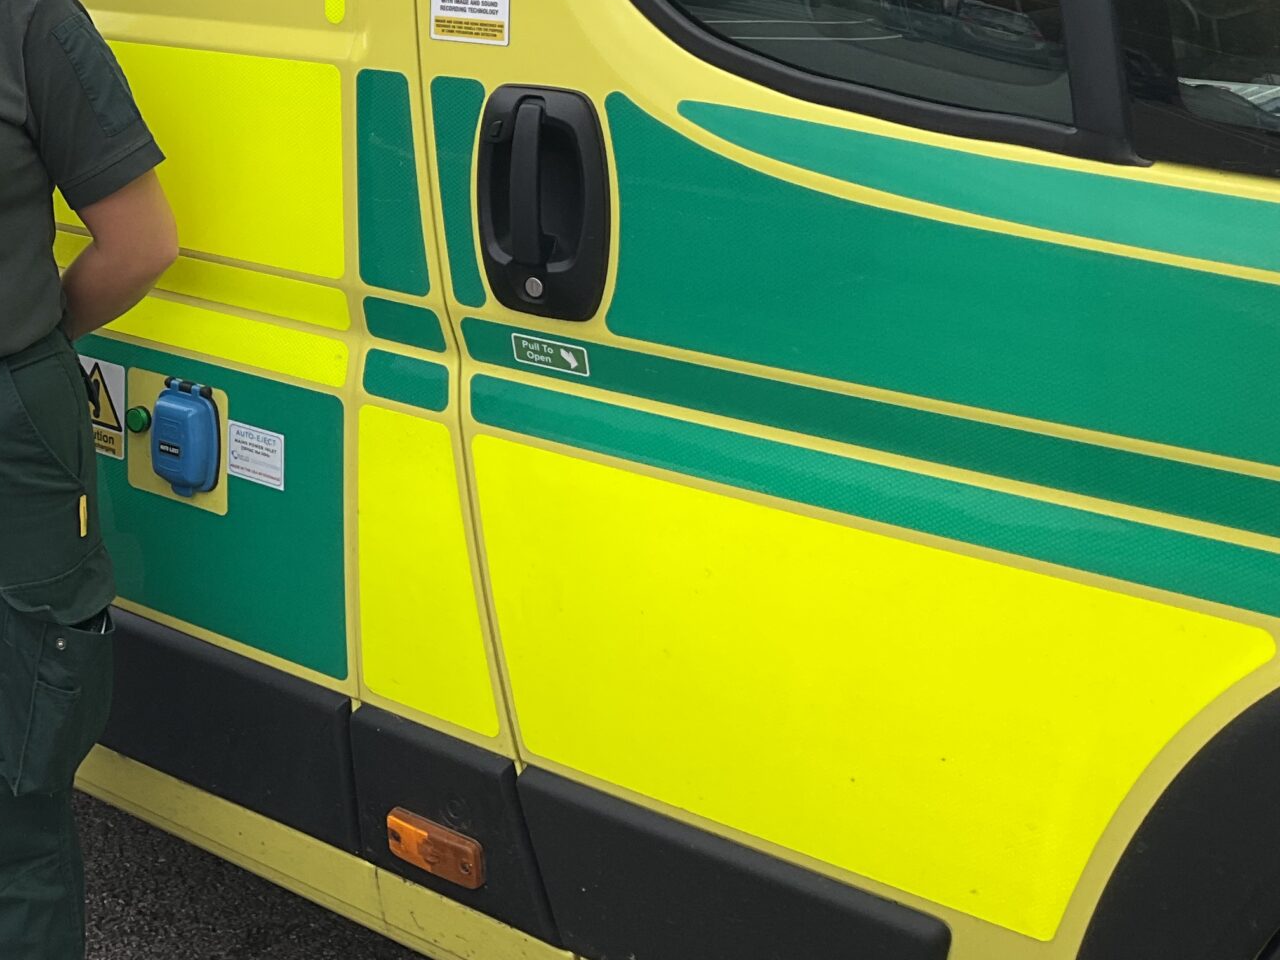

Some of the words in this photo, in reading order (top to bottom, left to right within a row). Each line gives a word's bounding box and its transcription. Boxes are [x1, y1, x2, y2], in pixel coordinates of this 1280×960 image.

[521, 340, 540, 351] Pull
[542, 344, 554, 354] To
[526, 351, 552, 363] Open
